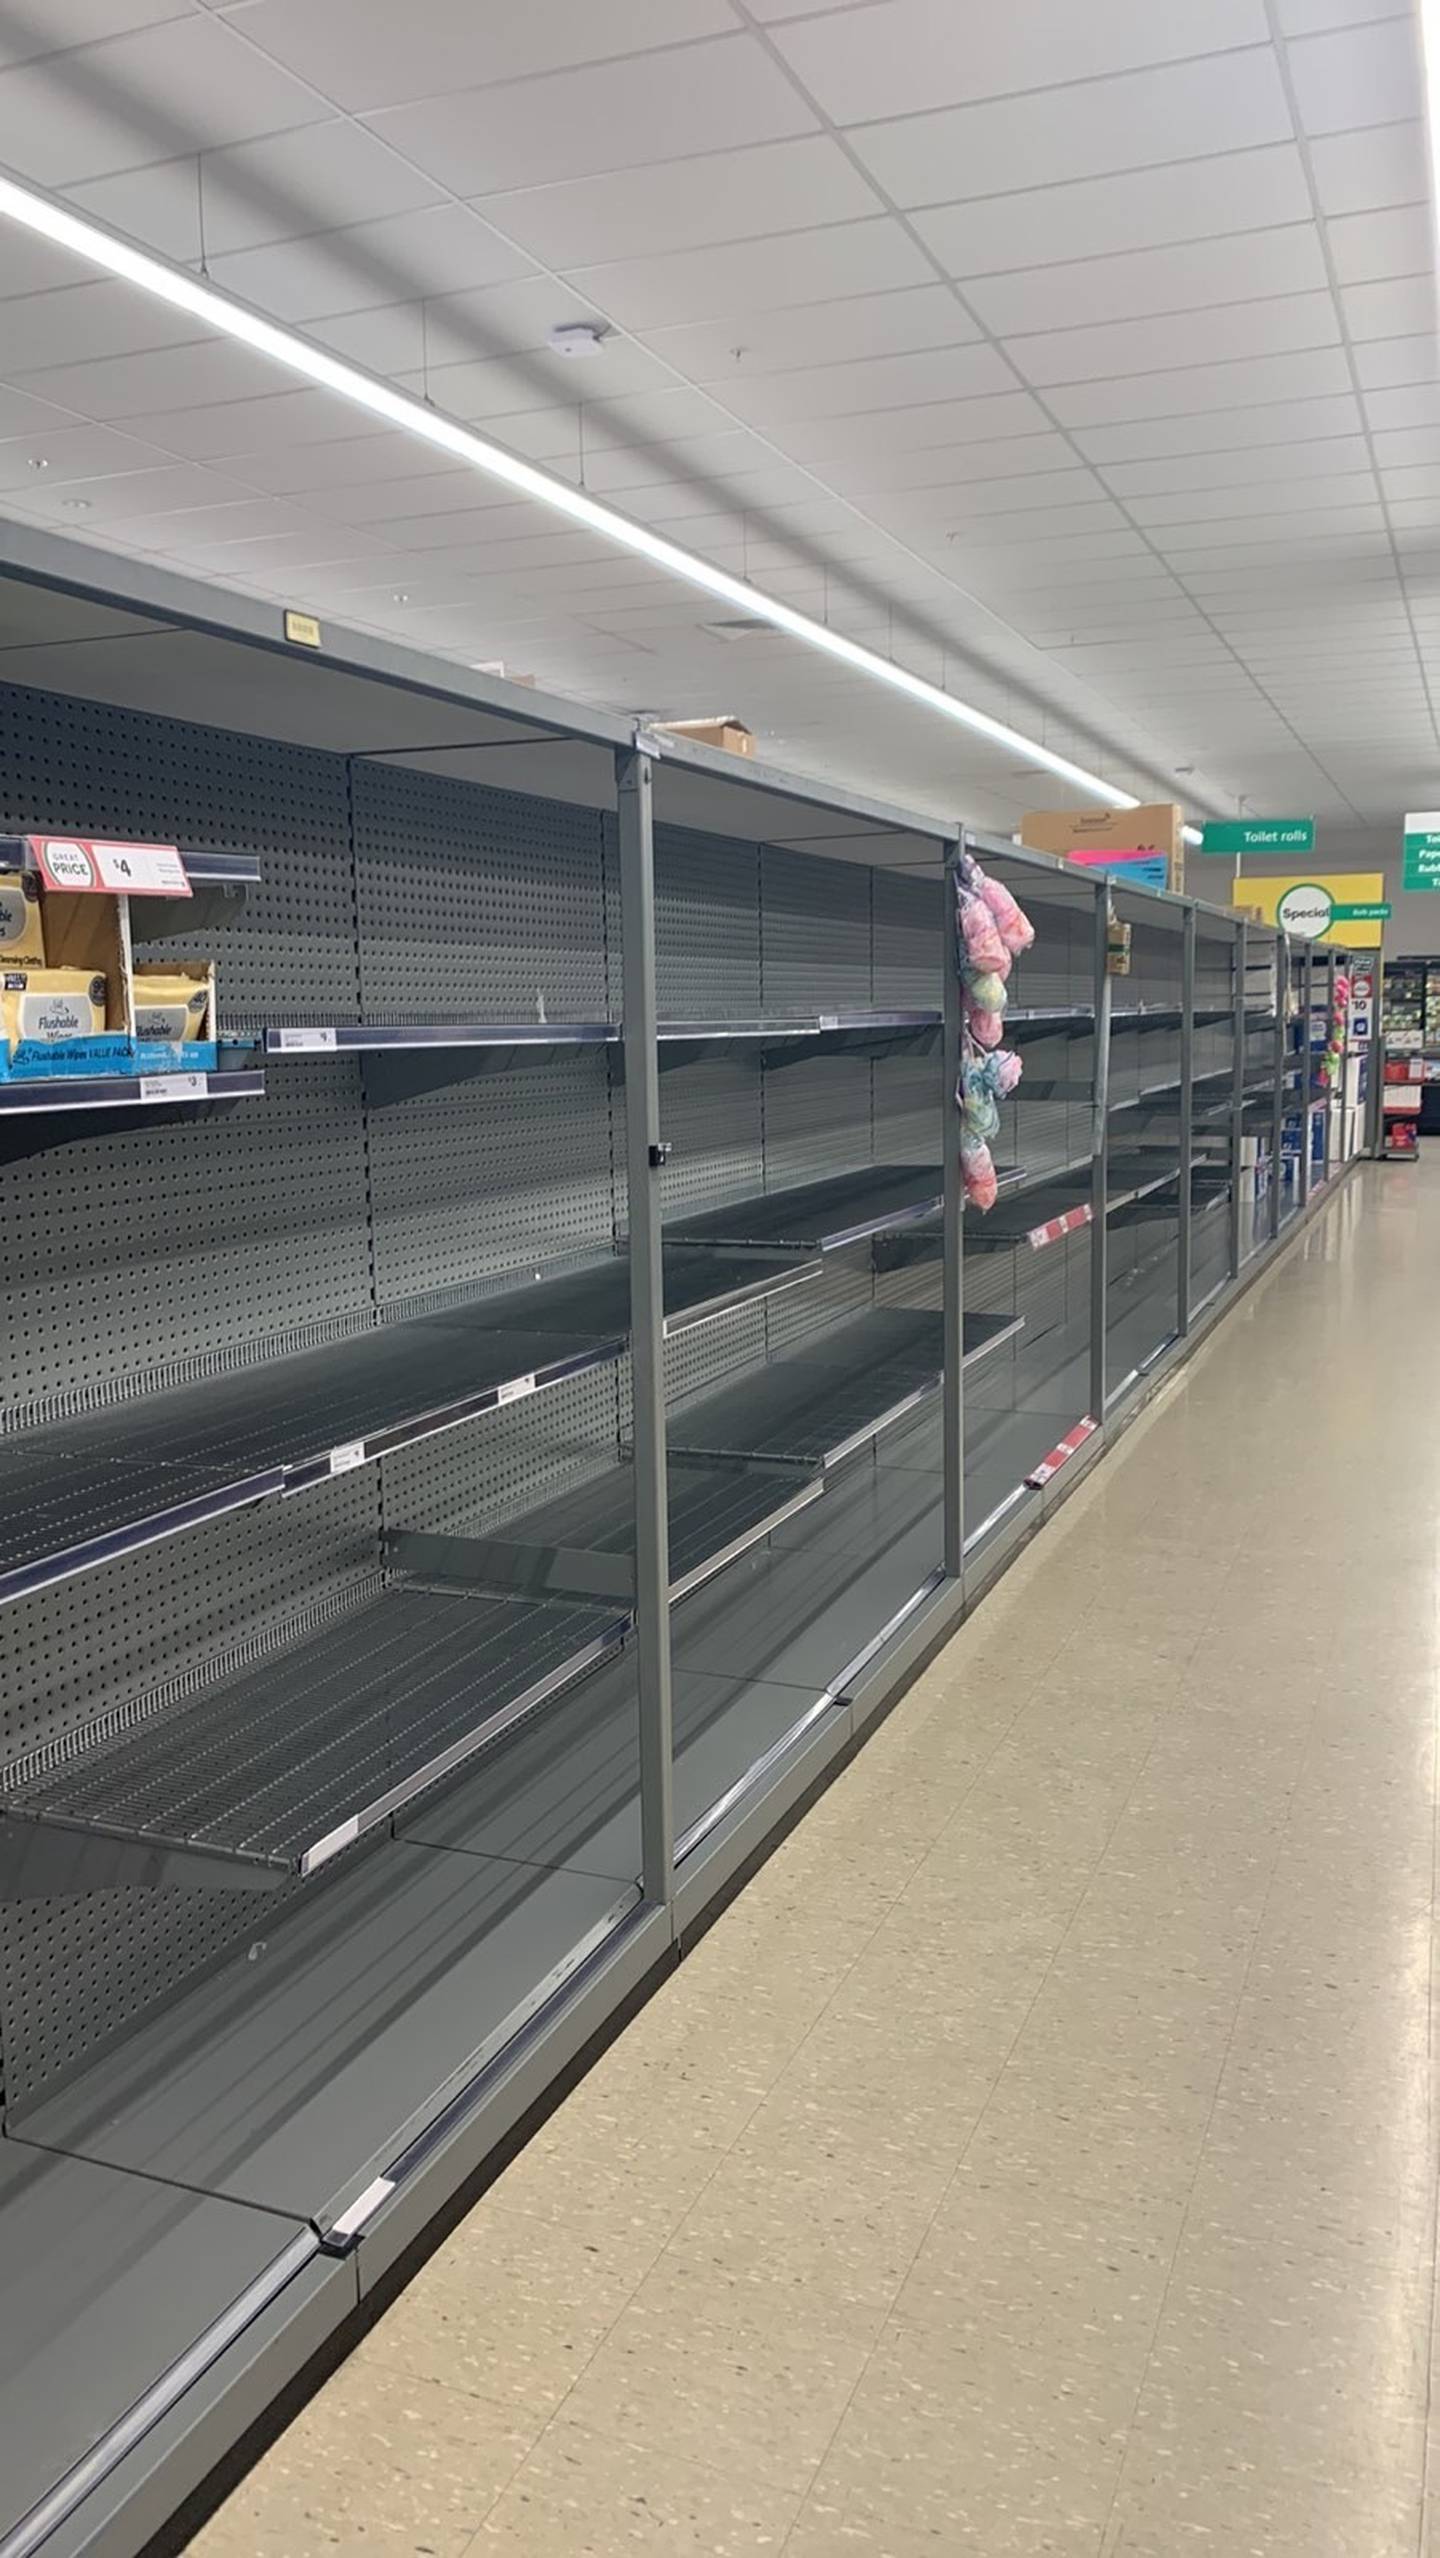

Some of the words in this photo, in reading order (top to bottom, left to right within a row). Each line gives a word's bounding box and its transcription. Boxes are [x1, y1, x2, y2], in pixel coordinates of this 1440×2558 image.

[1243, 830, 1278, 842] Toilet
[1280, 829, 1308, 842] rolls
[52, 852, 80, 862] GREAT
[52, 862, 89, 876] PRICE
[112, 858, 132, 877] $4
[1282, 907, 1330, 921] Special
[38, 1015, 79, 1030] Flushable
